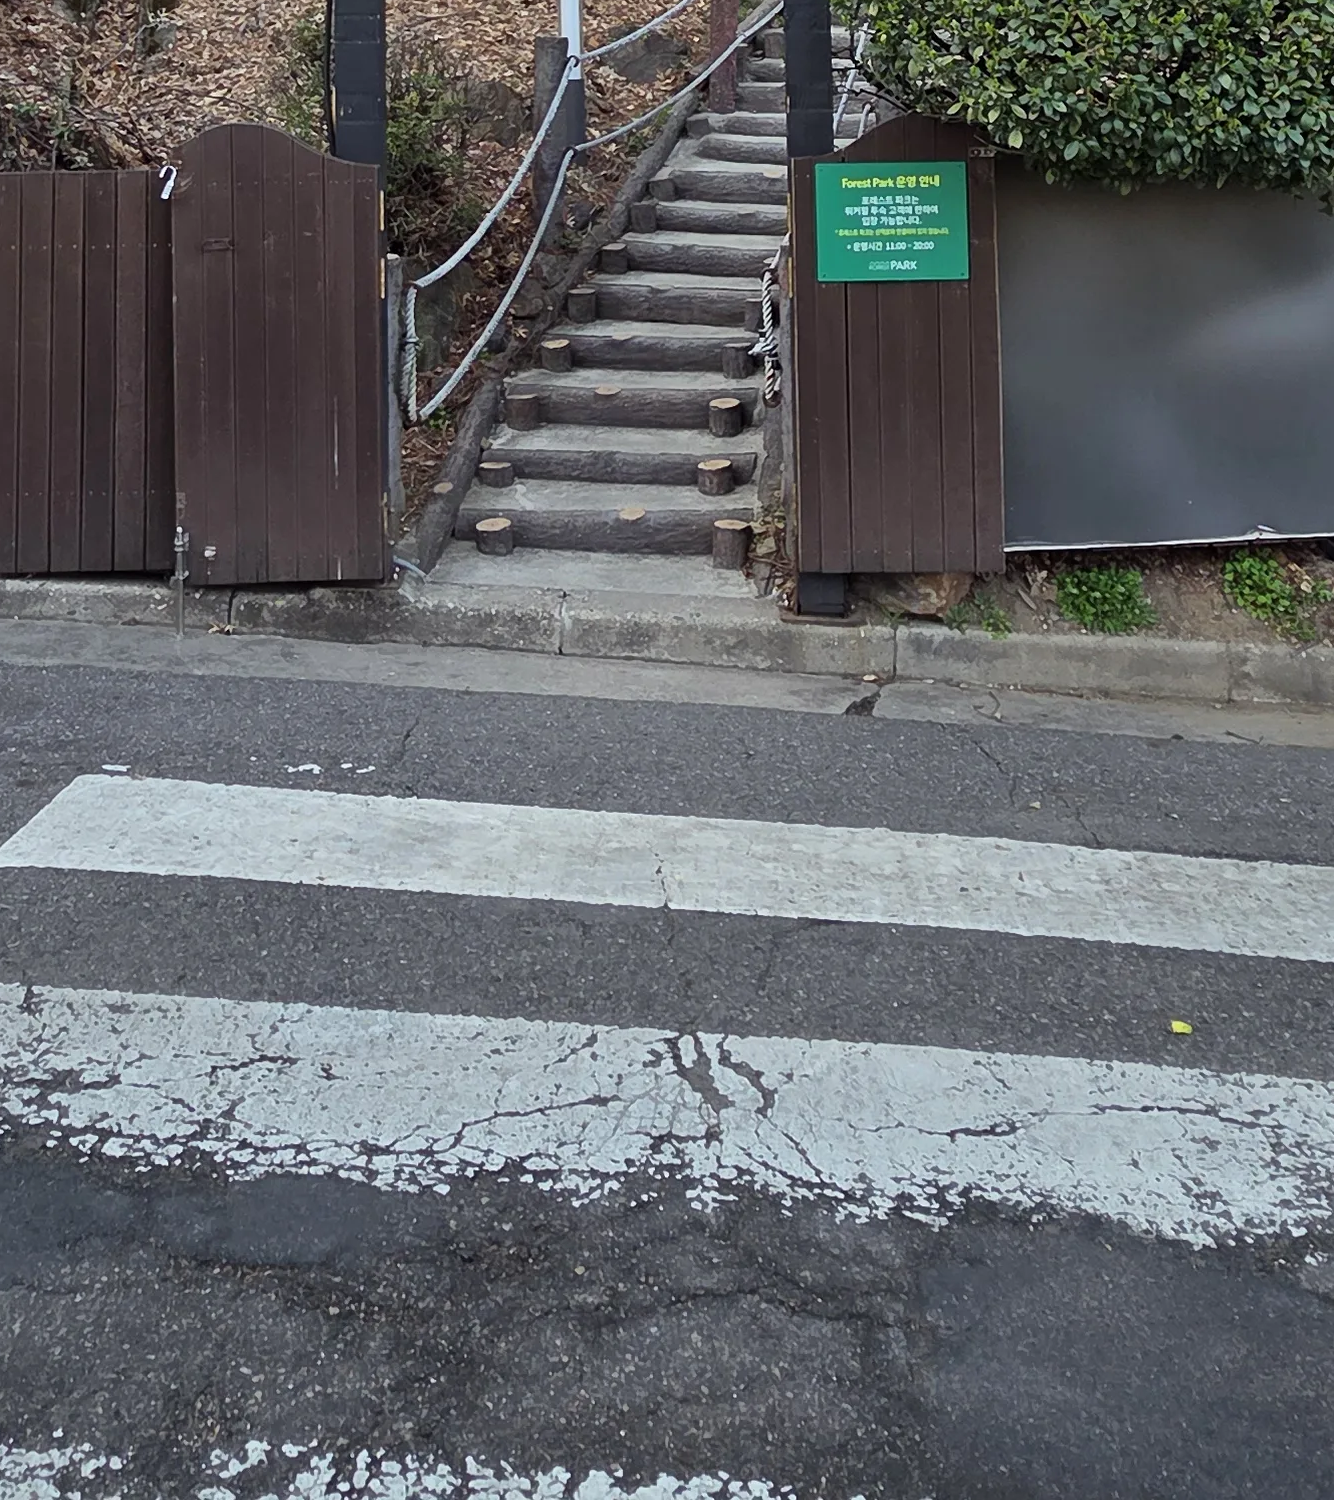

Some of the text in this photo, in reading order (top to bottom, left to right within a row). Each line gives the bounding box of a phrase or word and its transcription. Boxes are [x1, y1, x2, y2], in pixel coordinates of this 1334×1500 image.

[841, 174, 940, 189] Forest Park 운영 안내
[853, 241, 883, 252] 운영시간
[885, 242, 907, 251] 11:00
[912, 241, 935, 251] 20:00
[889, 260, 918, 271] PARK
